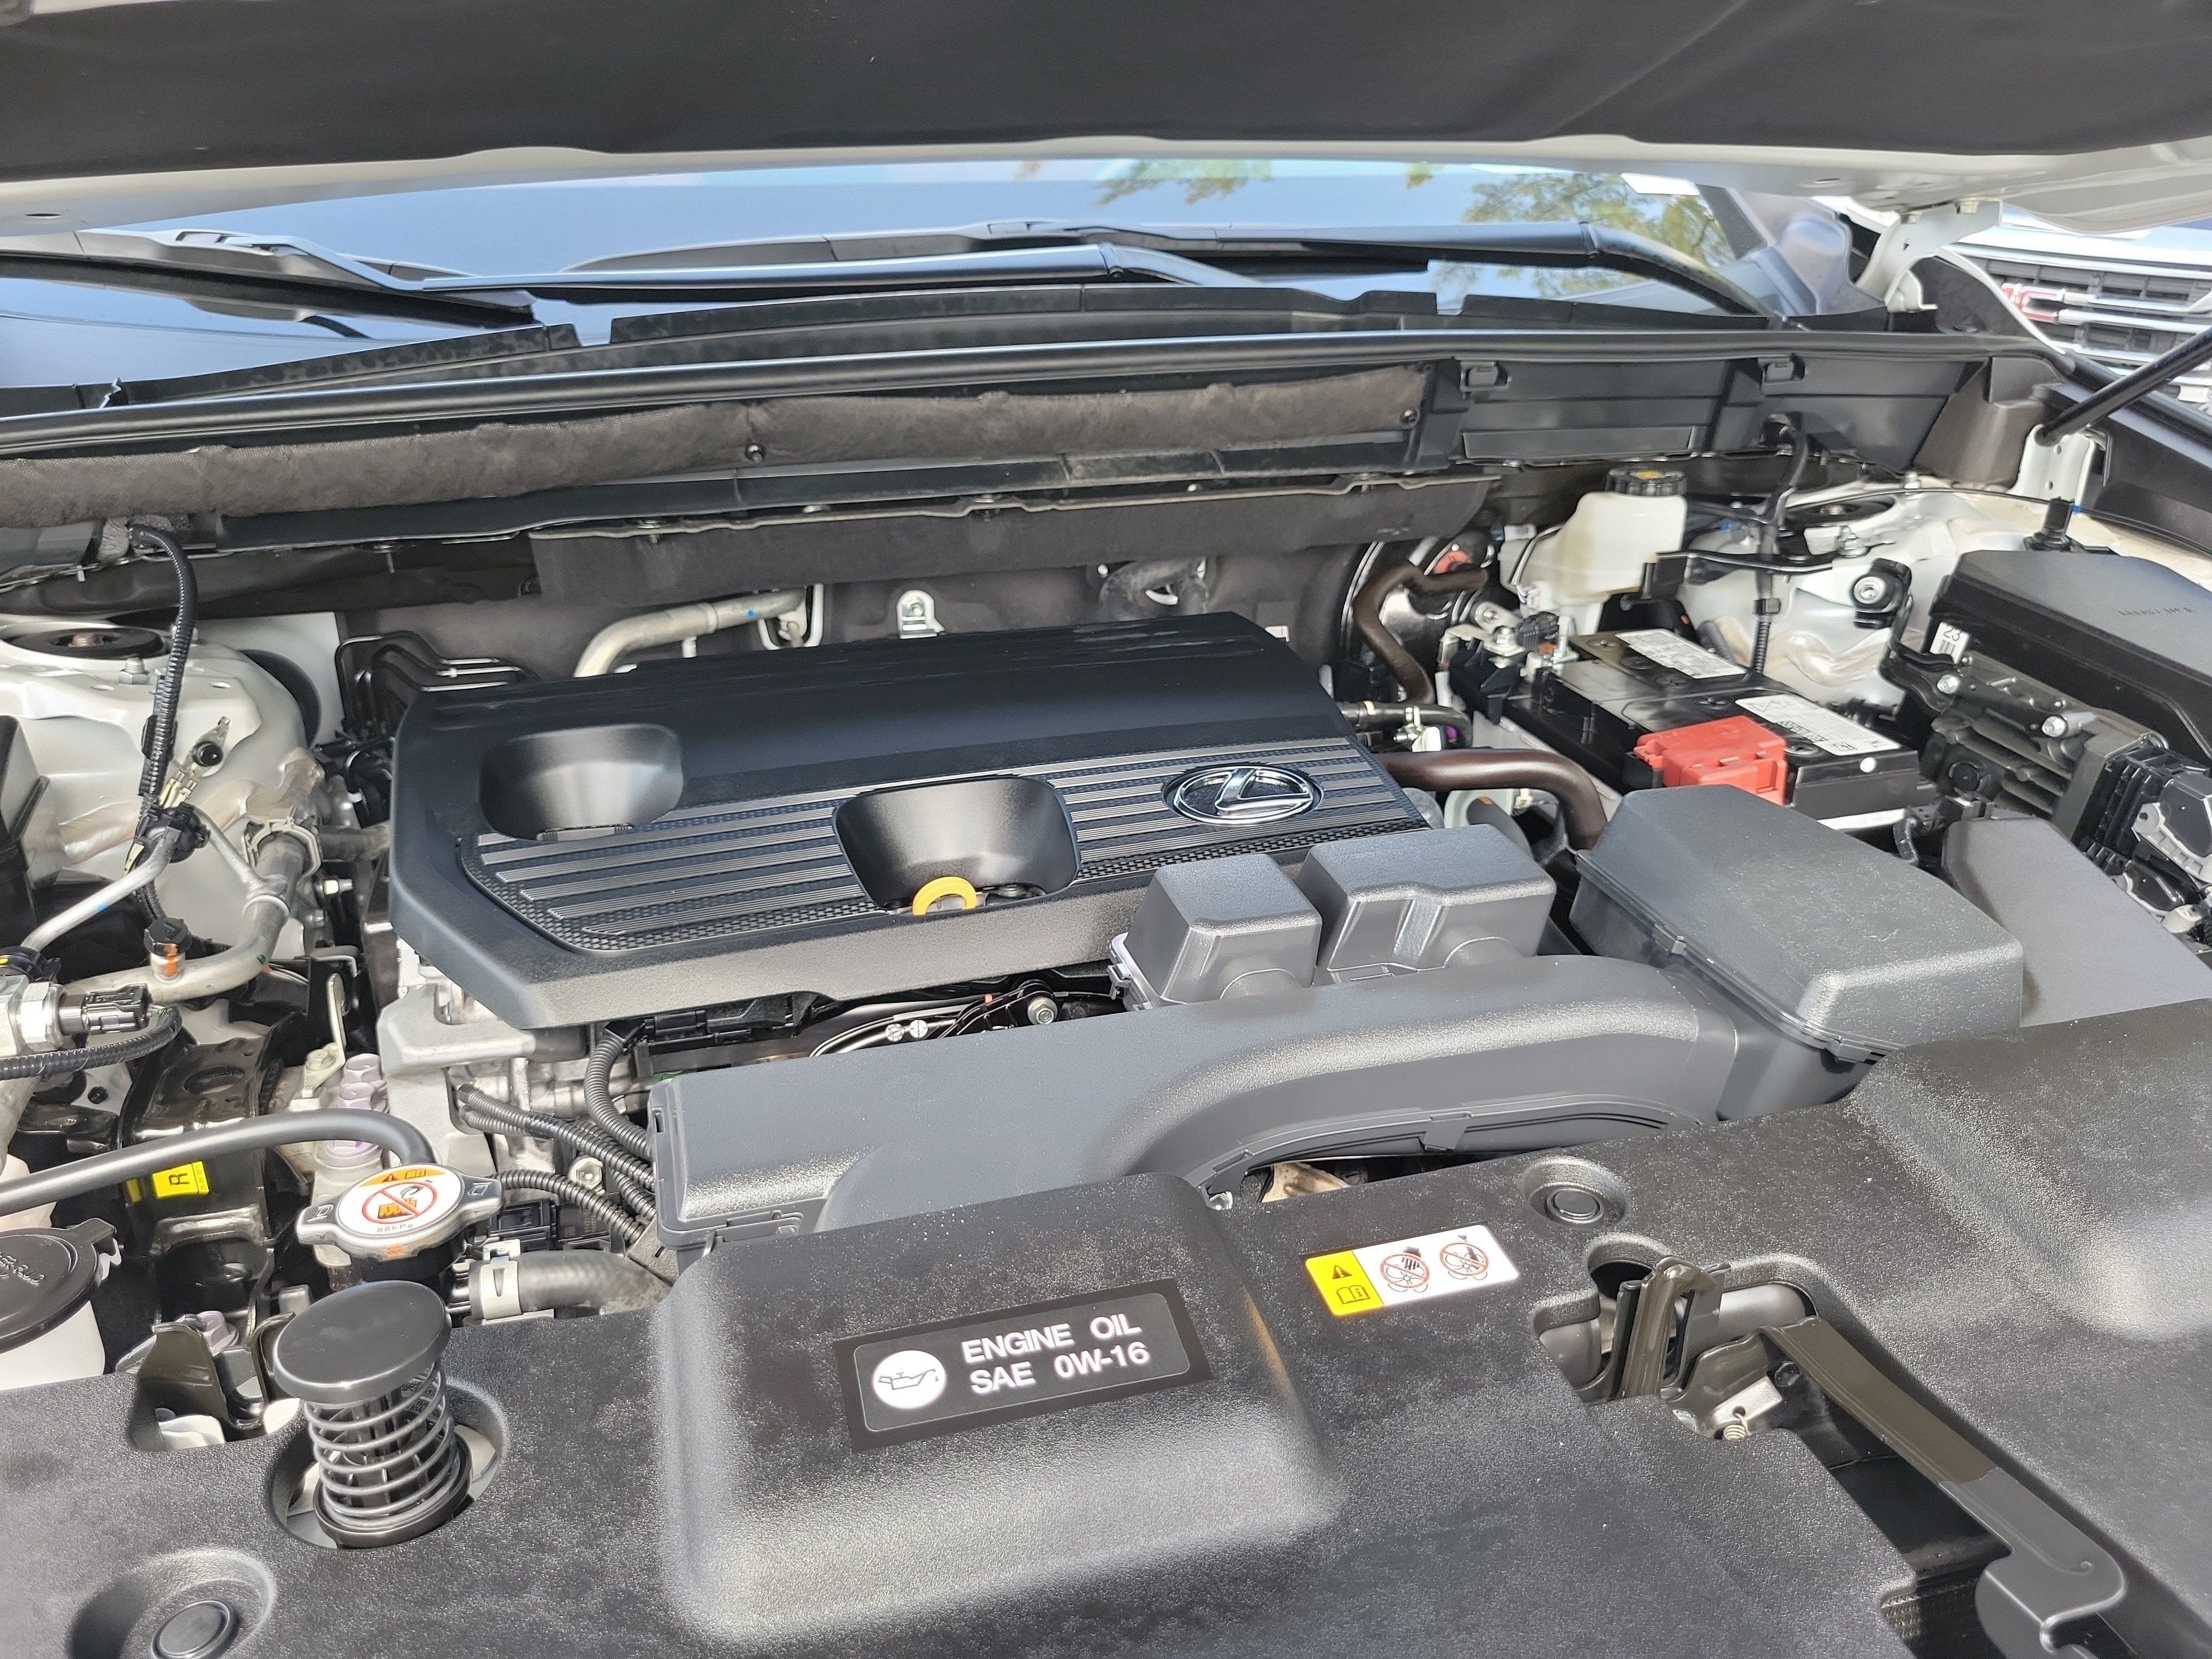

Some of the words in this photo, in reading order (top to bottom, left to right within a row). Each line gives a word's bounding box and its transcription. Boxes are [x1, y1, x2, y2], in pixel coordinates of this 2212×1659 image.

[168, 1172, 190, 1186] R
[962, 1323, 1074, 1364] ENGINE
[1090, 1314, 1141, 1340] OIL
[971, 1361, 1035, 1395] SAE
[1054, 1341, 1149, 1378] 0W-16
